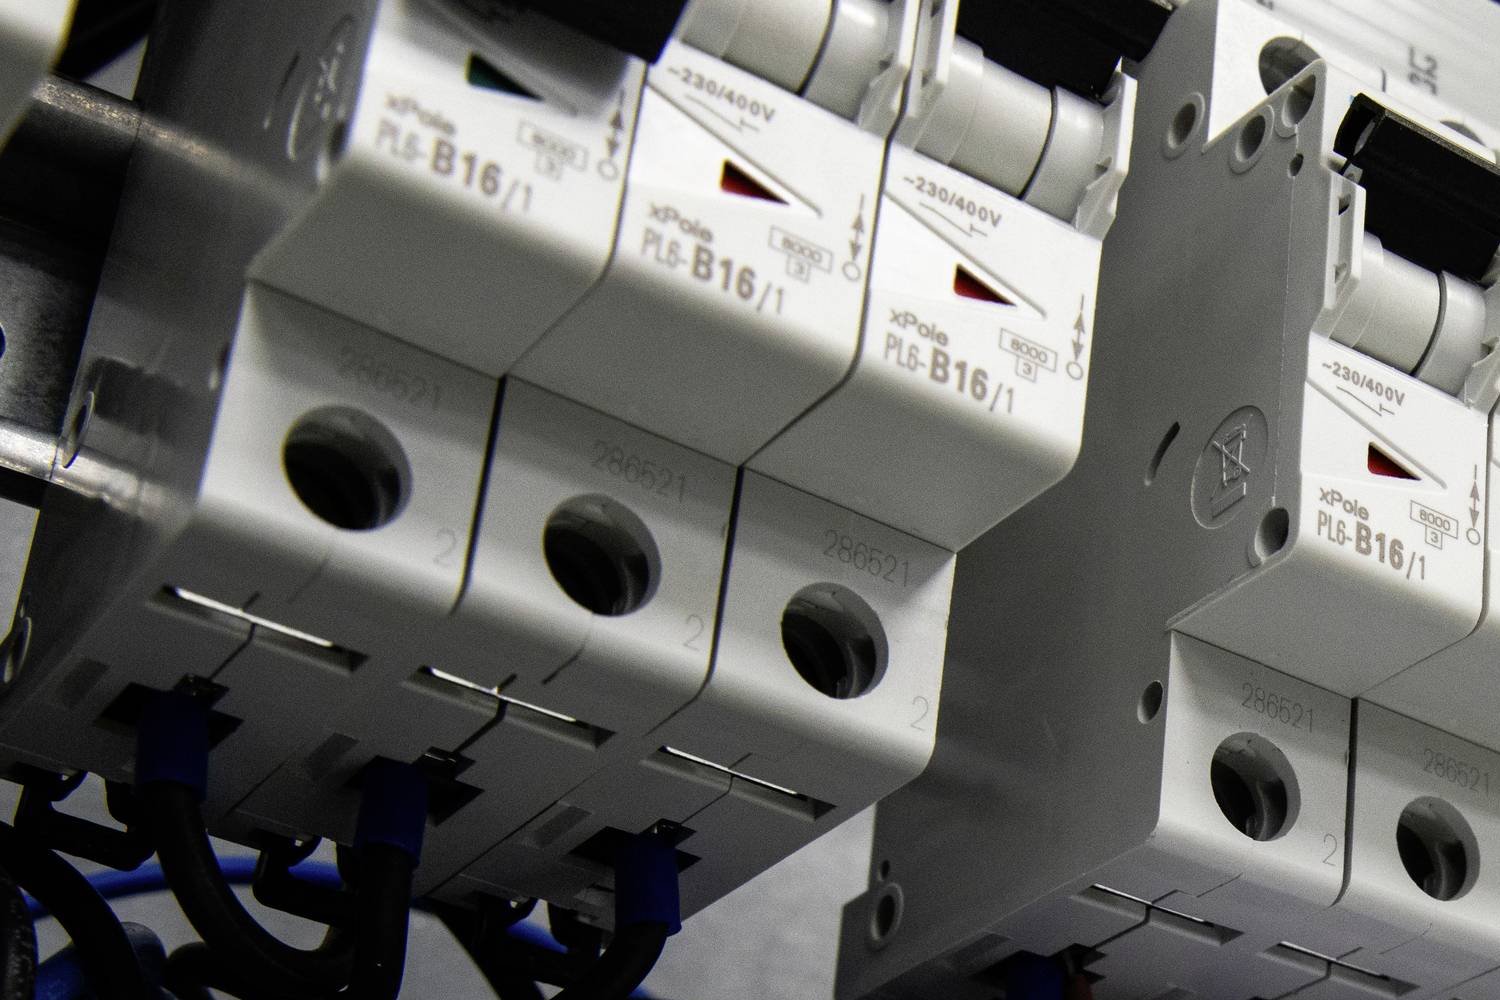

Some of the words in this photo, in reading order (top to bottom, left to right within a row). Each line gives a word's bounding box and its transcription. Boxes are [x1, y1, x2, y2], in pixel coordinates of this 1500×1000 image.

[903, 176, 1002, 228] ~230/400V
[648, 202, 715, 244] xPole
[889, 309, 949, 347] xPole
[1322, 362, 1406, 407] ~230/400V
[1319, 487, 1370, 521] xPole
[1430, 531, 1440, 544] 3
[823, 529, 909, 588] 286521
[683, 614, 704, 651] 2
[910, 696, 930, 731] 2
[1241, 682, 1313, 733] 286521
[1423, 749, 1490, 797] 286521
[1322, 833, 1338, 866] 2
